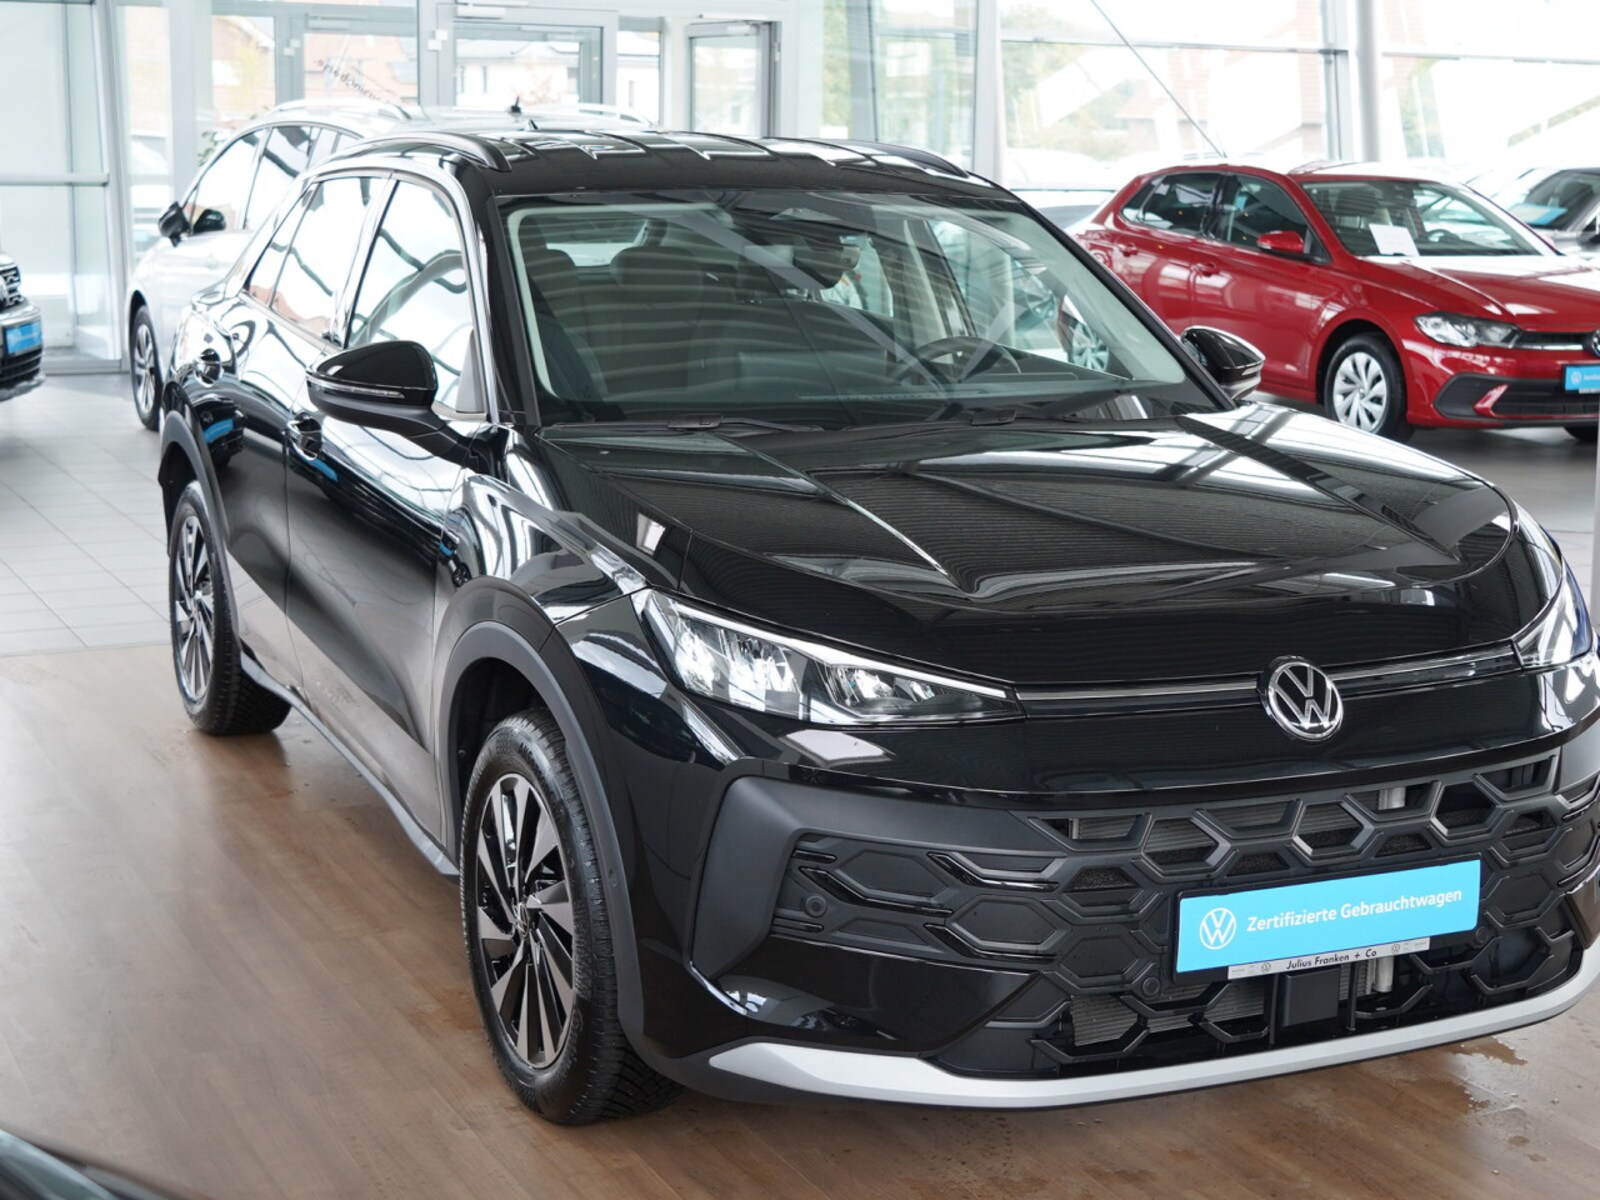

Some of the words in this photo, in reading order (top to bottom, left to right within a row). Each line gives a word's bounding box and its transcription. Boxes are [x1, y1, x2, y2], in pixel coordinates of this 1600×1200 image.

[1268, 661, 1342, 738] VW
[1200, 907, 1236, 950] VW
[1247, 908, 1336, 932] Zertifizierte
[1340, 889, 1462, 919] Gebrauchtwagen
[1286, 958, 1312, 970] Julius
[1314, 954, 1349, 967] Franken
[1365, 948, 1377, 958] Co
